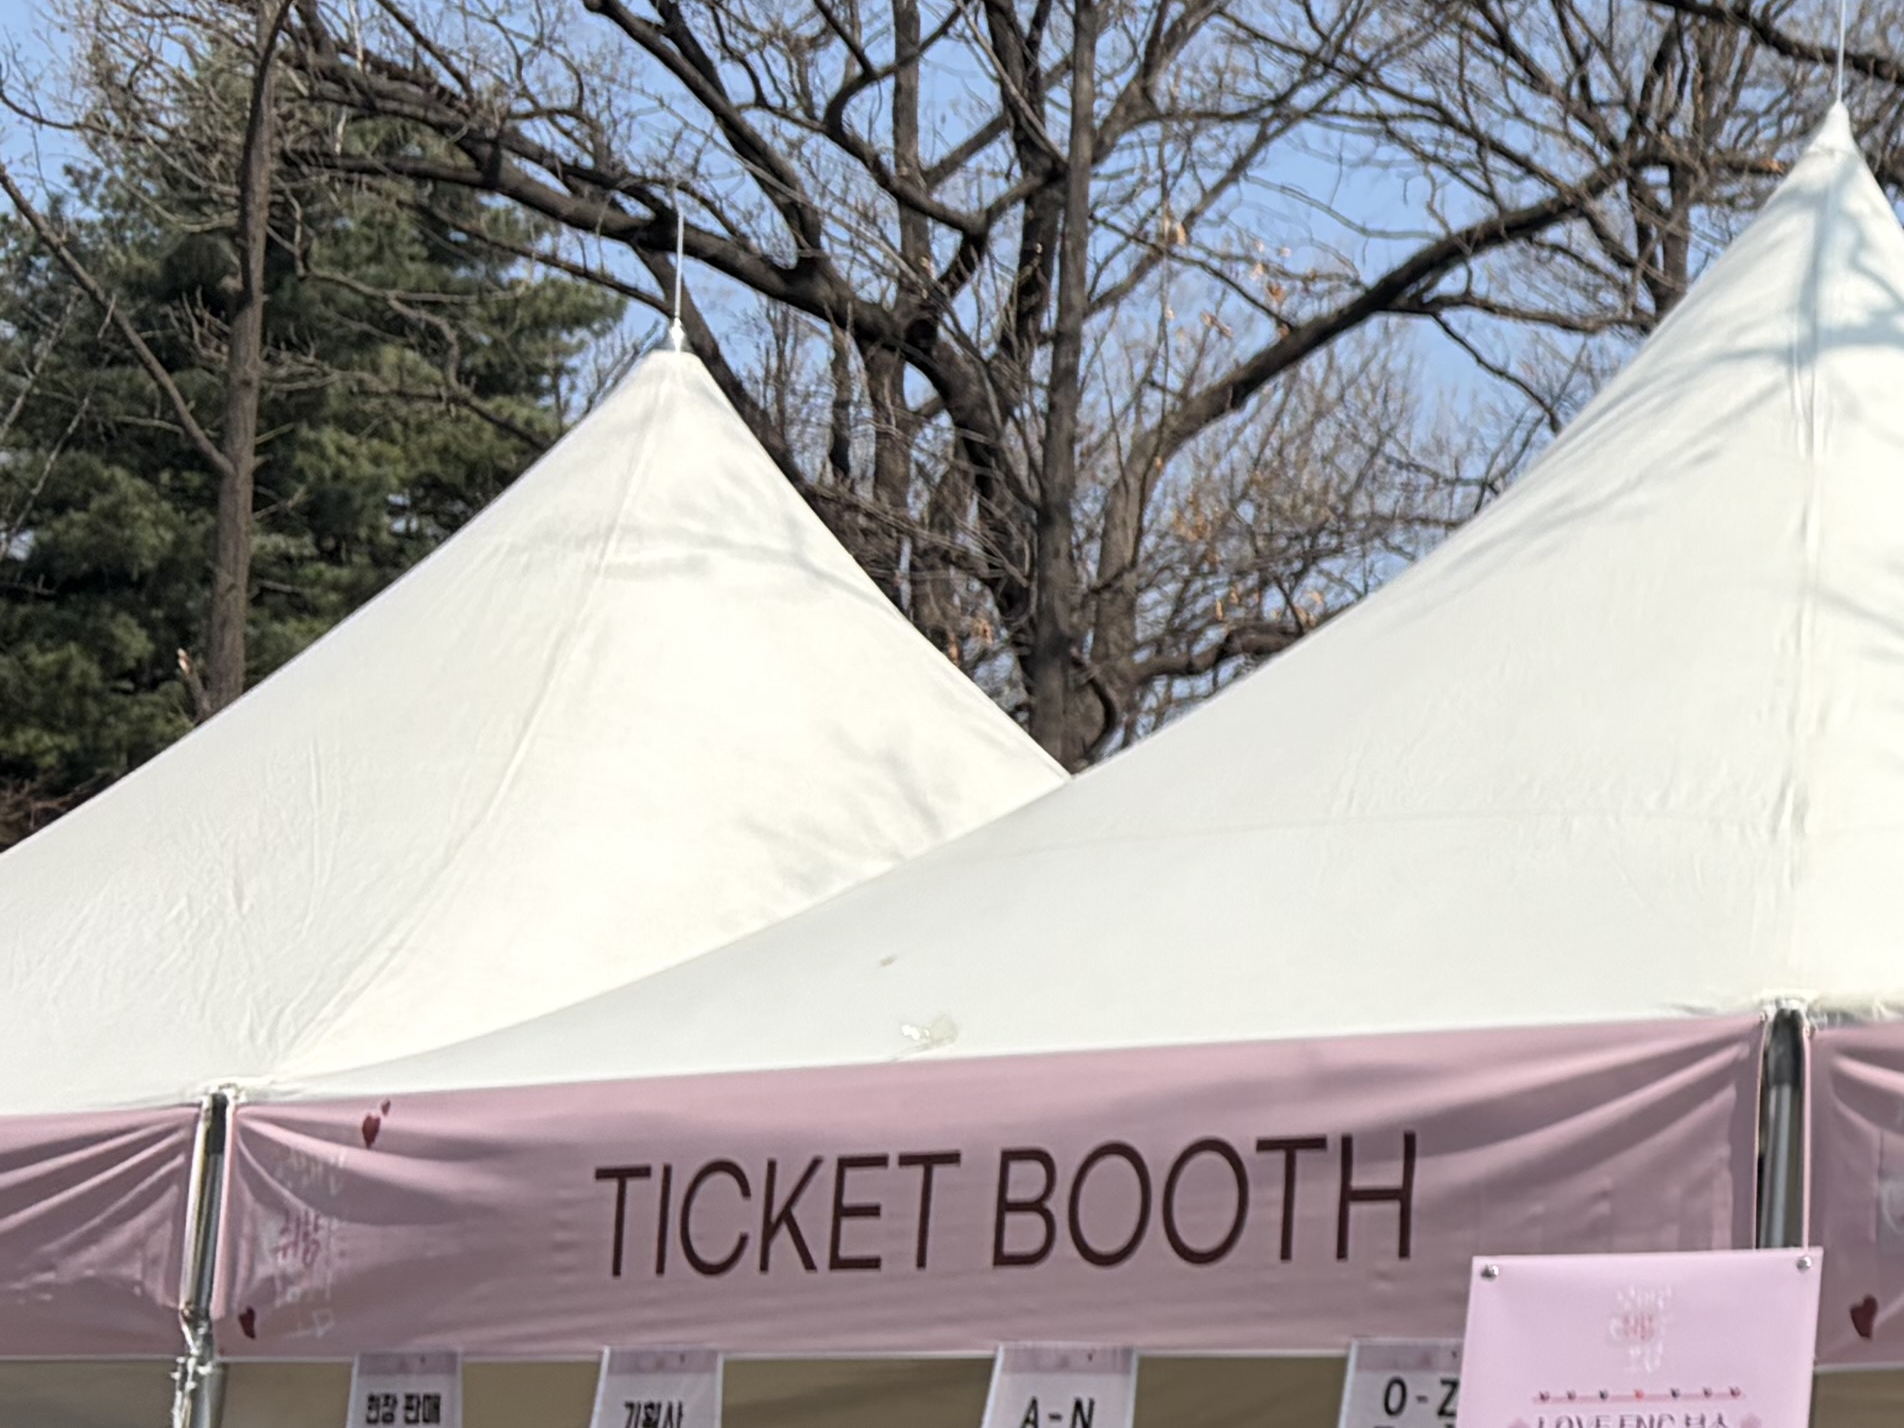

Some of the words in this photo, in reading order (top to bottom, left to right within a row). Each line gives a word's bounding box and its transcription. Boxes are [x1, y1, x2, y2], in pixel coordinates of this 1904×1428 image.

[594, 1150, 962, 1278] TICKET
[992, 1130, 1418, 1269] BOOTH
[366, 1392, 398, 1425] 현장
[404, 1392, 441, 1425] 판매
